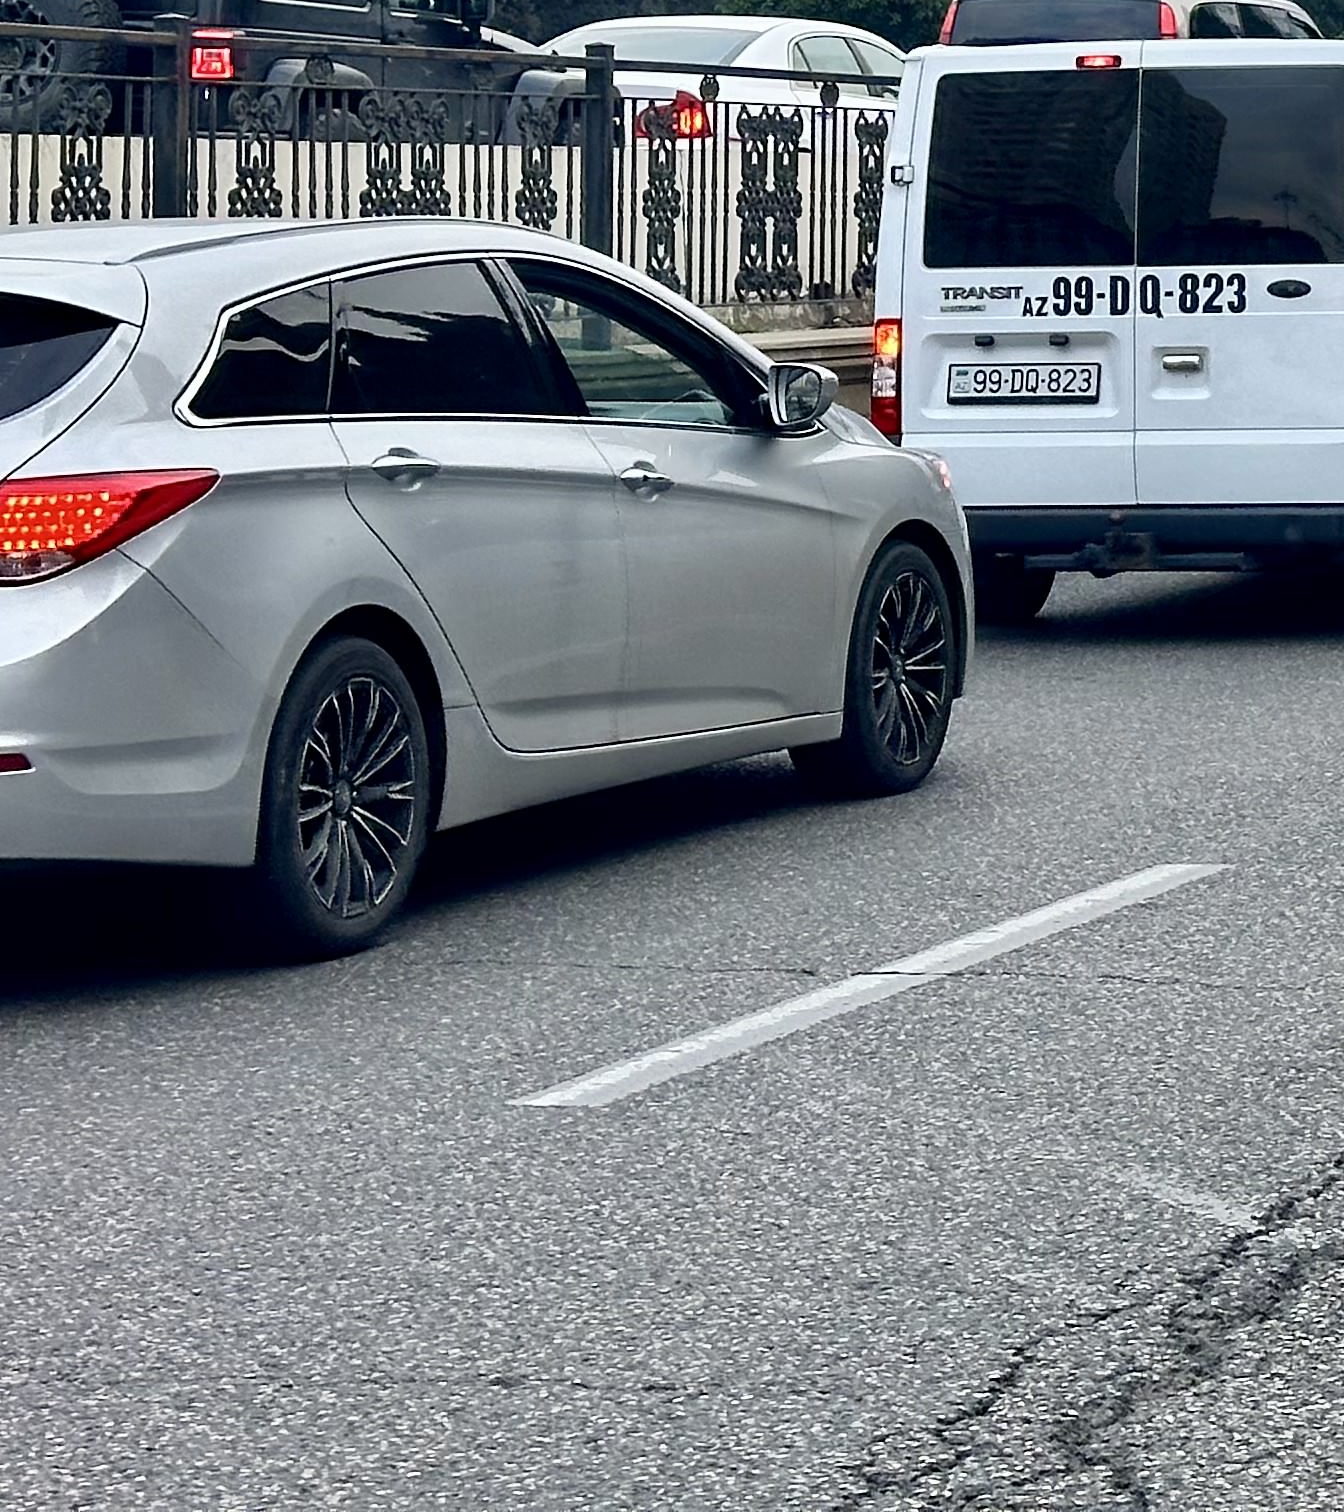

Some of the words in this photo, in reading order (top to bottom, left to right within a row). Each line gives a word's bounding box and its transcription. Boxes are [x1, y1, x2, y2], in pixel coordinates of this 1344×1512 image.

[940, 286, 1024, 300] TRANSIT
[1022, 296, 1049, 317] AZ
[973, 368, 1092, 394] 99-DQ-823
